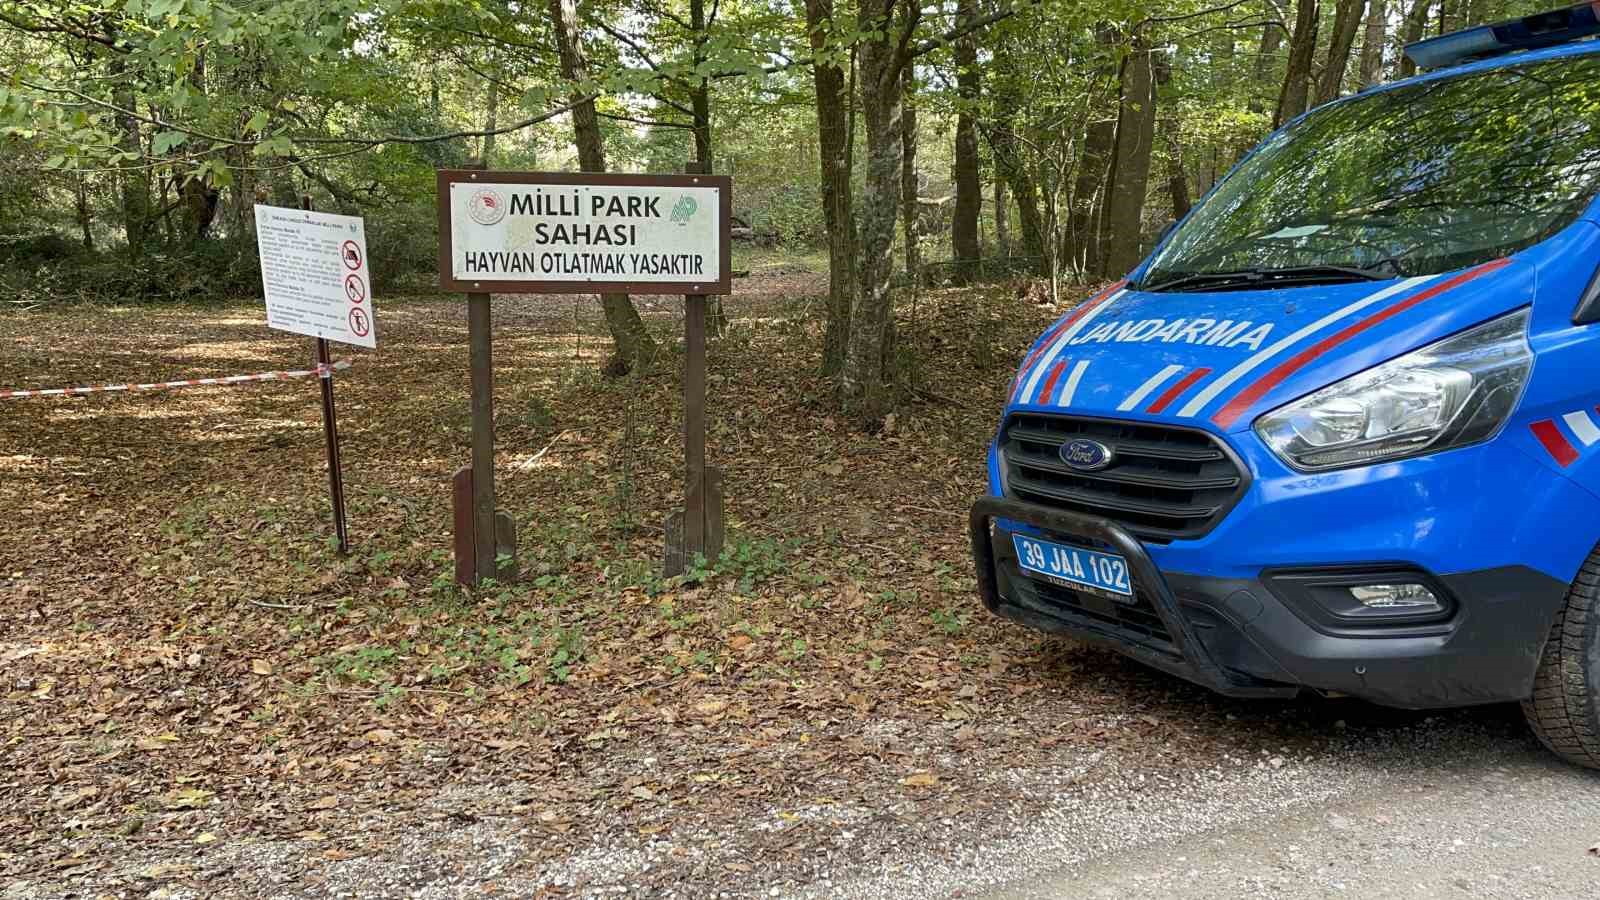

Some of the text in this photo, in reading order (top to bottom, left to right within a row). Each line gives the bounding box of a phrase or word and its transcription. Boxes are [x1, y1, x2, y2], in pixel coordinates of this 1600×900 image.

[509, 189, 580, 216] MİLLİ
[591, 195, 661, 218] PARK
[535, 223, 636, 246] SAHASI
[465, 251, 703, 275] HAYVAN OTLATMAK YASAKTIR
[1069, 318, 1274, 350] JANDARMA
[1066, 442, 1095, 463] Ford
[1023, 541, 1127, 589] 39 JAA 102
